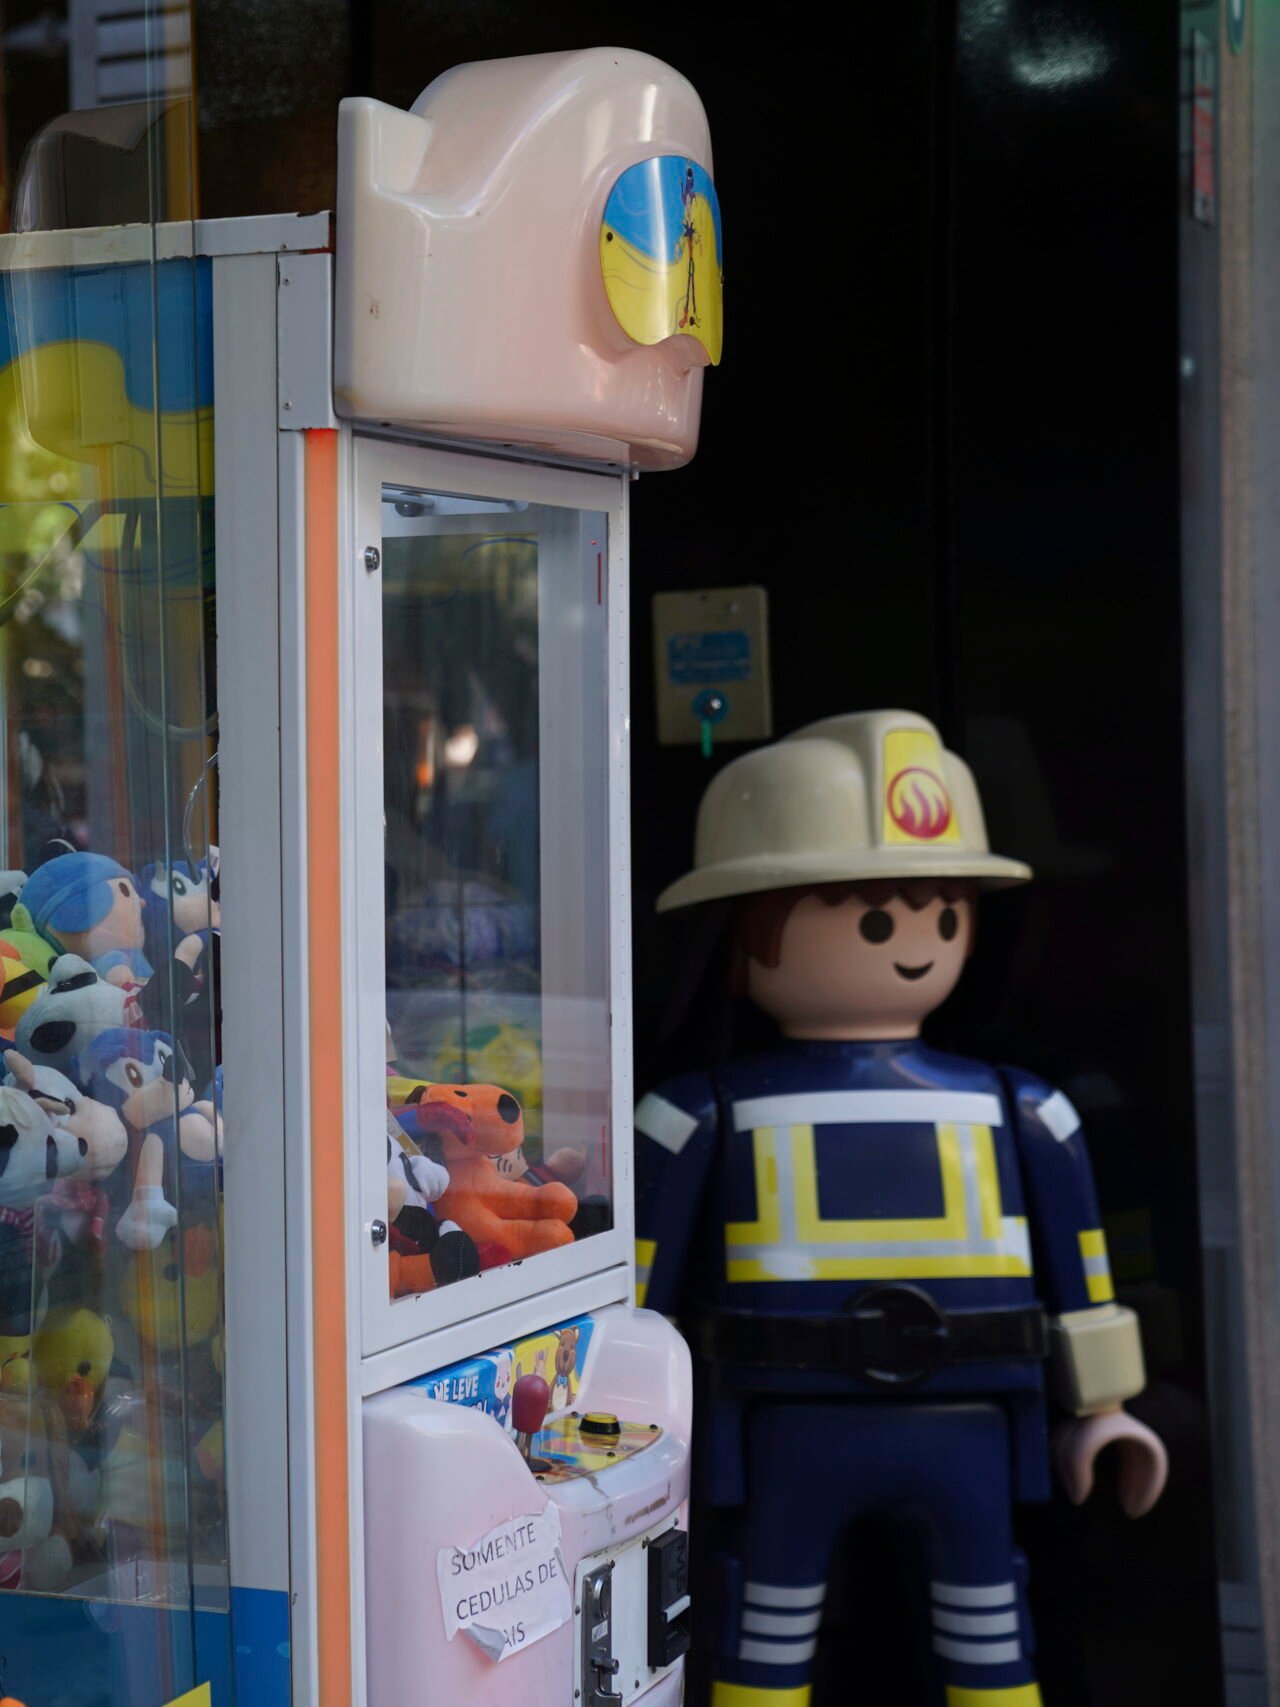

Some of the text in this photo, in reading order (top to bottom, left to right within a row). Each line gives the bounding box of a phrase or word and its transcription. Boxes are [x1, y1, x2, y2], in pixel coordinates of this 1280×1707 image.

[433, 1375, 479, 1401] ME LEVE
[451, 1522, 537, 1576] SOMENTE
[456, 1557, 558, 1620] CEDULAS DE
[503, 1621, 526, 1648] AIS
